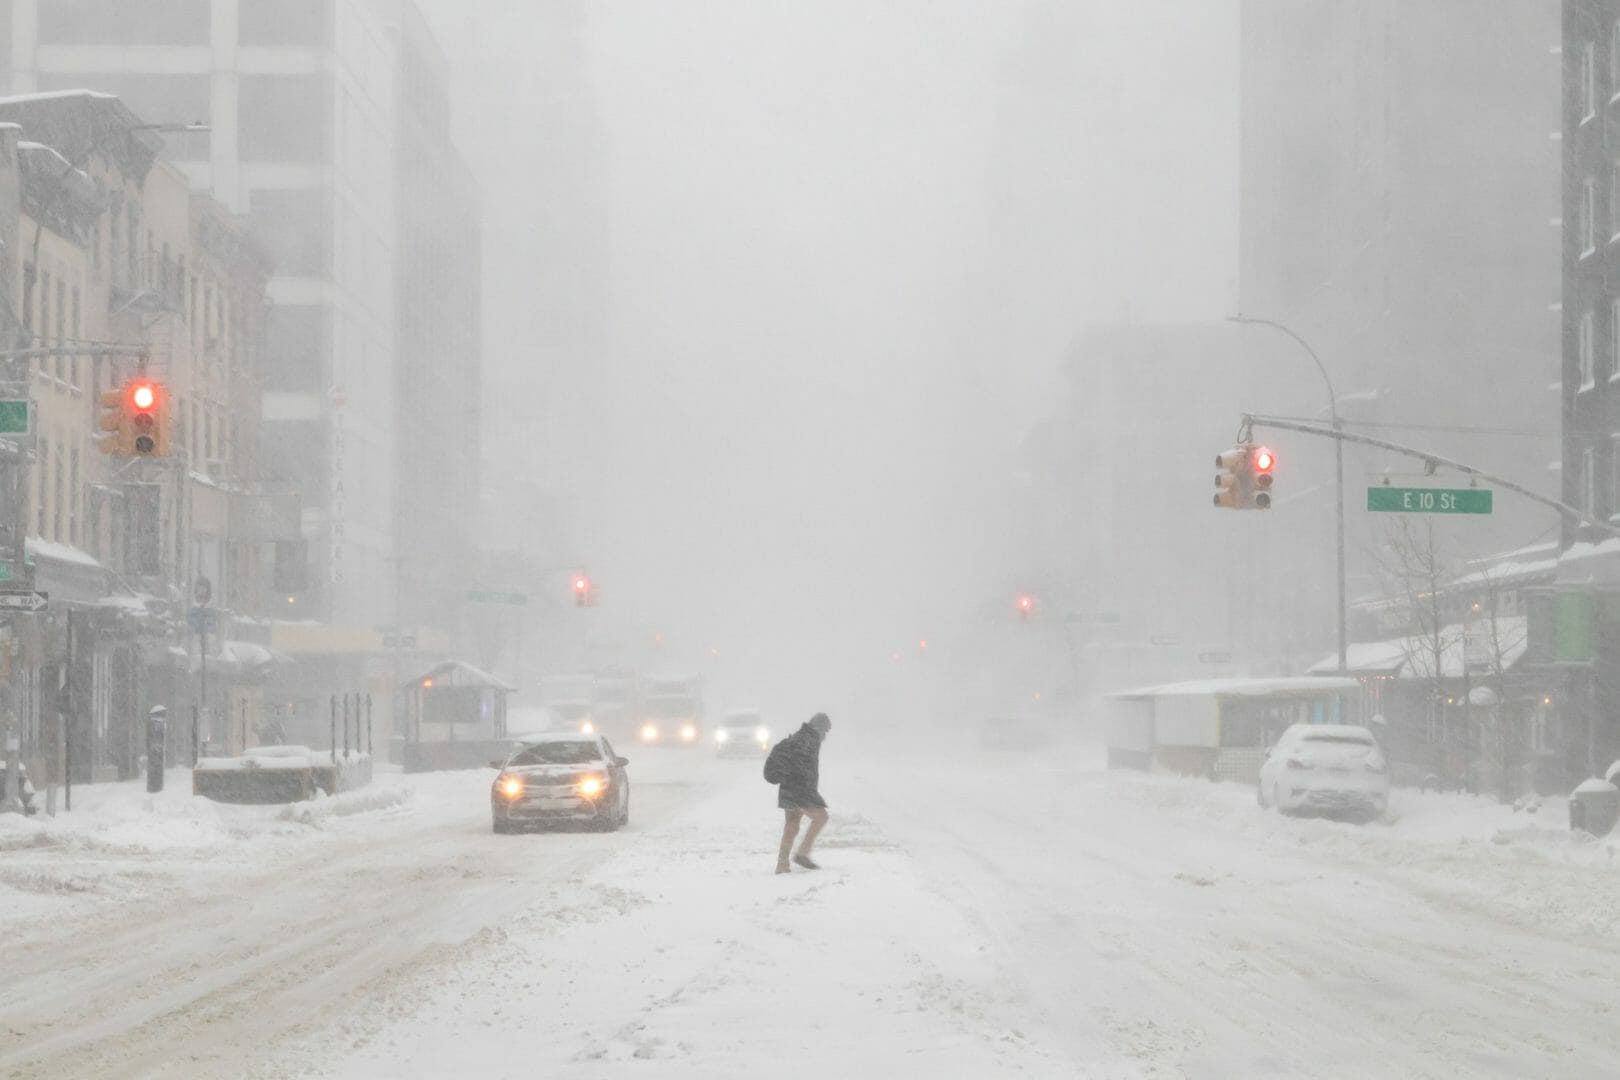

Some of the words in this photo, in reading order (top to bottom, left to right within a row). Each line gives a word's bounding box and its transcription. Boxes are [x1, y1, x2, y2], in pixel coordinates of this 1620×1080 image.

[335, 413, 345, 583] THEATRES
[1403, 492, 1413, 508] E
[1419, 492, 1434, 509] 10
[1440, 493, 1457, 509] St
[20, 597, 39, 605] WAY
